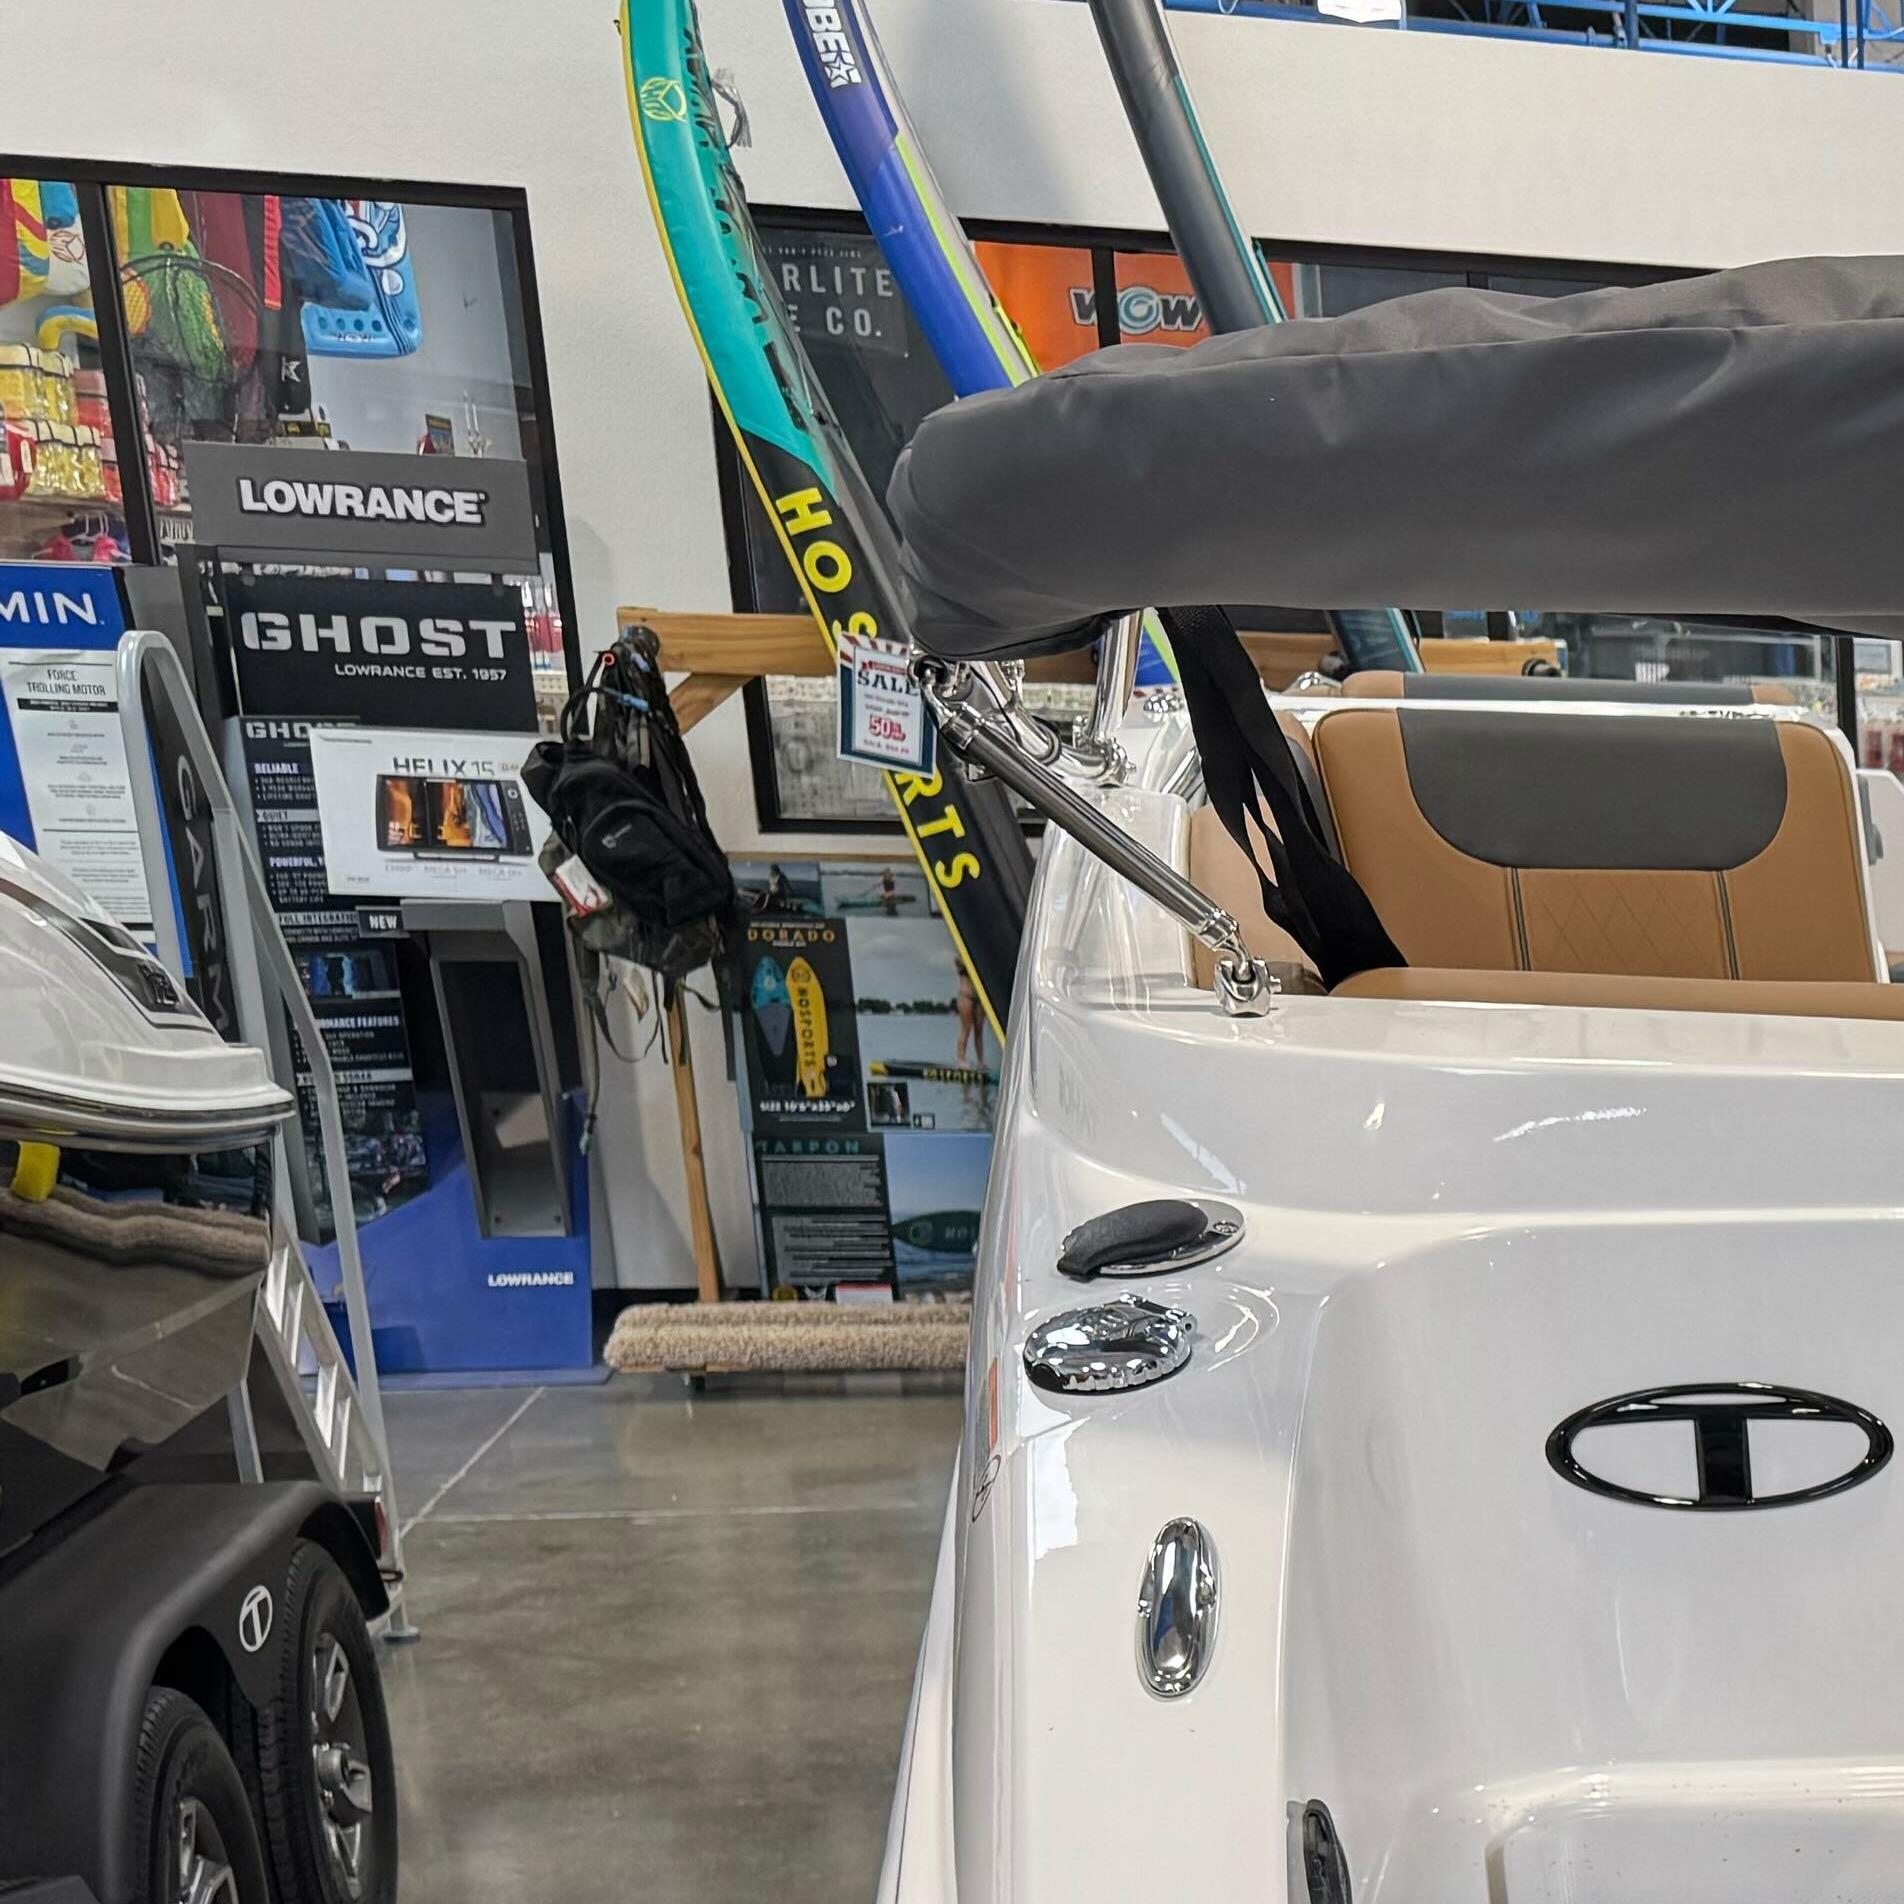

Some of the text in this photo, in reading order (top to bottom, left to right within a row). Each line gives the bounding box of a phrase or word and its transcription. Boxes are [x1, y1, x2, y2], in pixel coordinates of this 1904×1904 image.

[782, 263, 893, 296] RLITE
[826, 307, 882, 336] CO.
[1070, 287, 1202, 334] WOW
[239, 479, 484, 523] LOWRANCE
[0, 591, 98, 625] MIN
[240, 612, 516, 658] GHOST
[47, 669, 77, 681] FORCE
[335, 664, 507, 681] LOWRANCE EST. 1957
[27, 682, 106, 696] TROLLING MOTOR
[369, 914, 398, 930] NEW
[748, 929, 836, 943] DORADO
[487, 1271, 574, 1287] LOWRANCE
